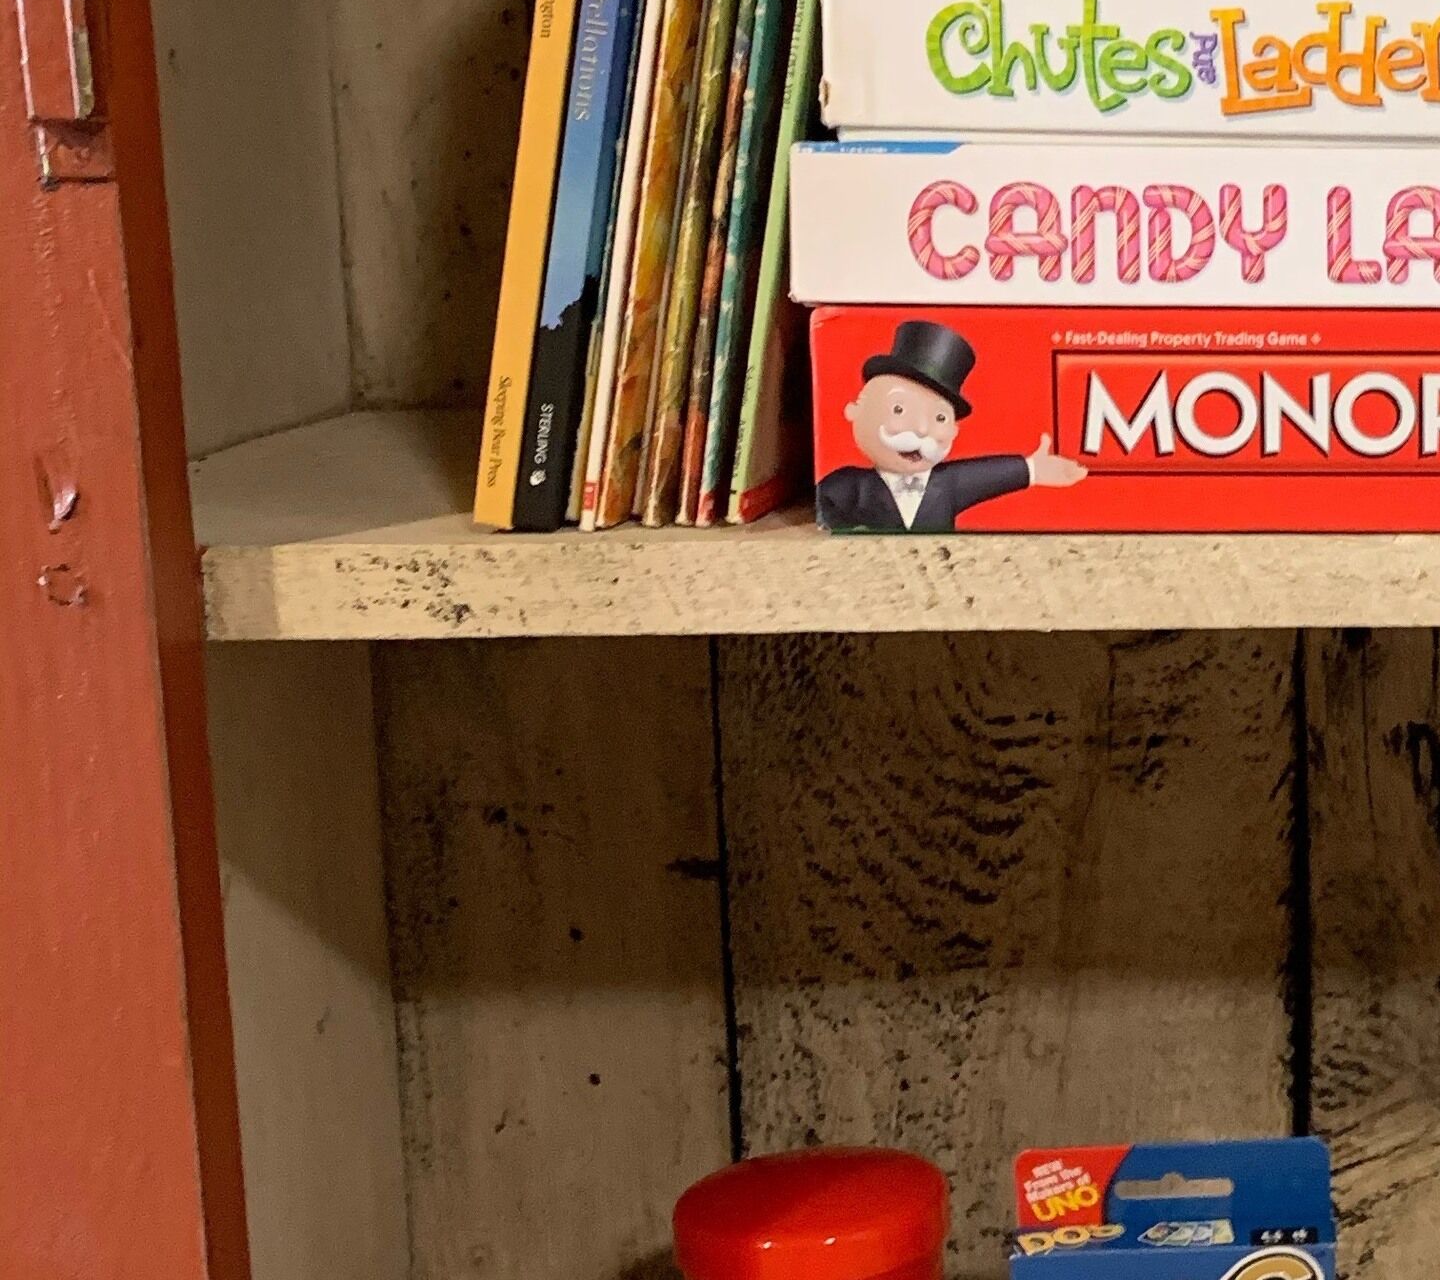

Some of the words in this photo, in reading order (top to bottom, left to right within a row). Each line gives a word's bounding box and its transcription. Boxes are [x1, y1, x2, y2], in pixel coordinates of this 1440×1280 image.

[907, 178, 1290, 285] CANDY
[1065, 331, 1148, 348] Fast-Dealing
[1150, 331, 1212, 348] Property
[1214, 331, 1265, 348] Trading
[1267, 332, 1308, 347] Game
[533, 402, 555, 466] STERLING
[1032, 1184, 1099, 1222] UNO
